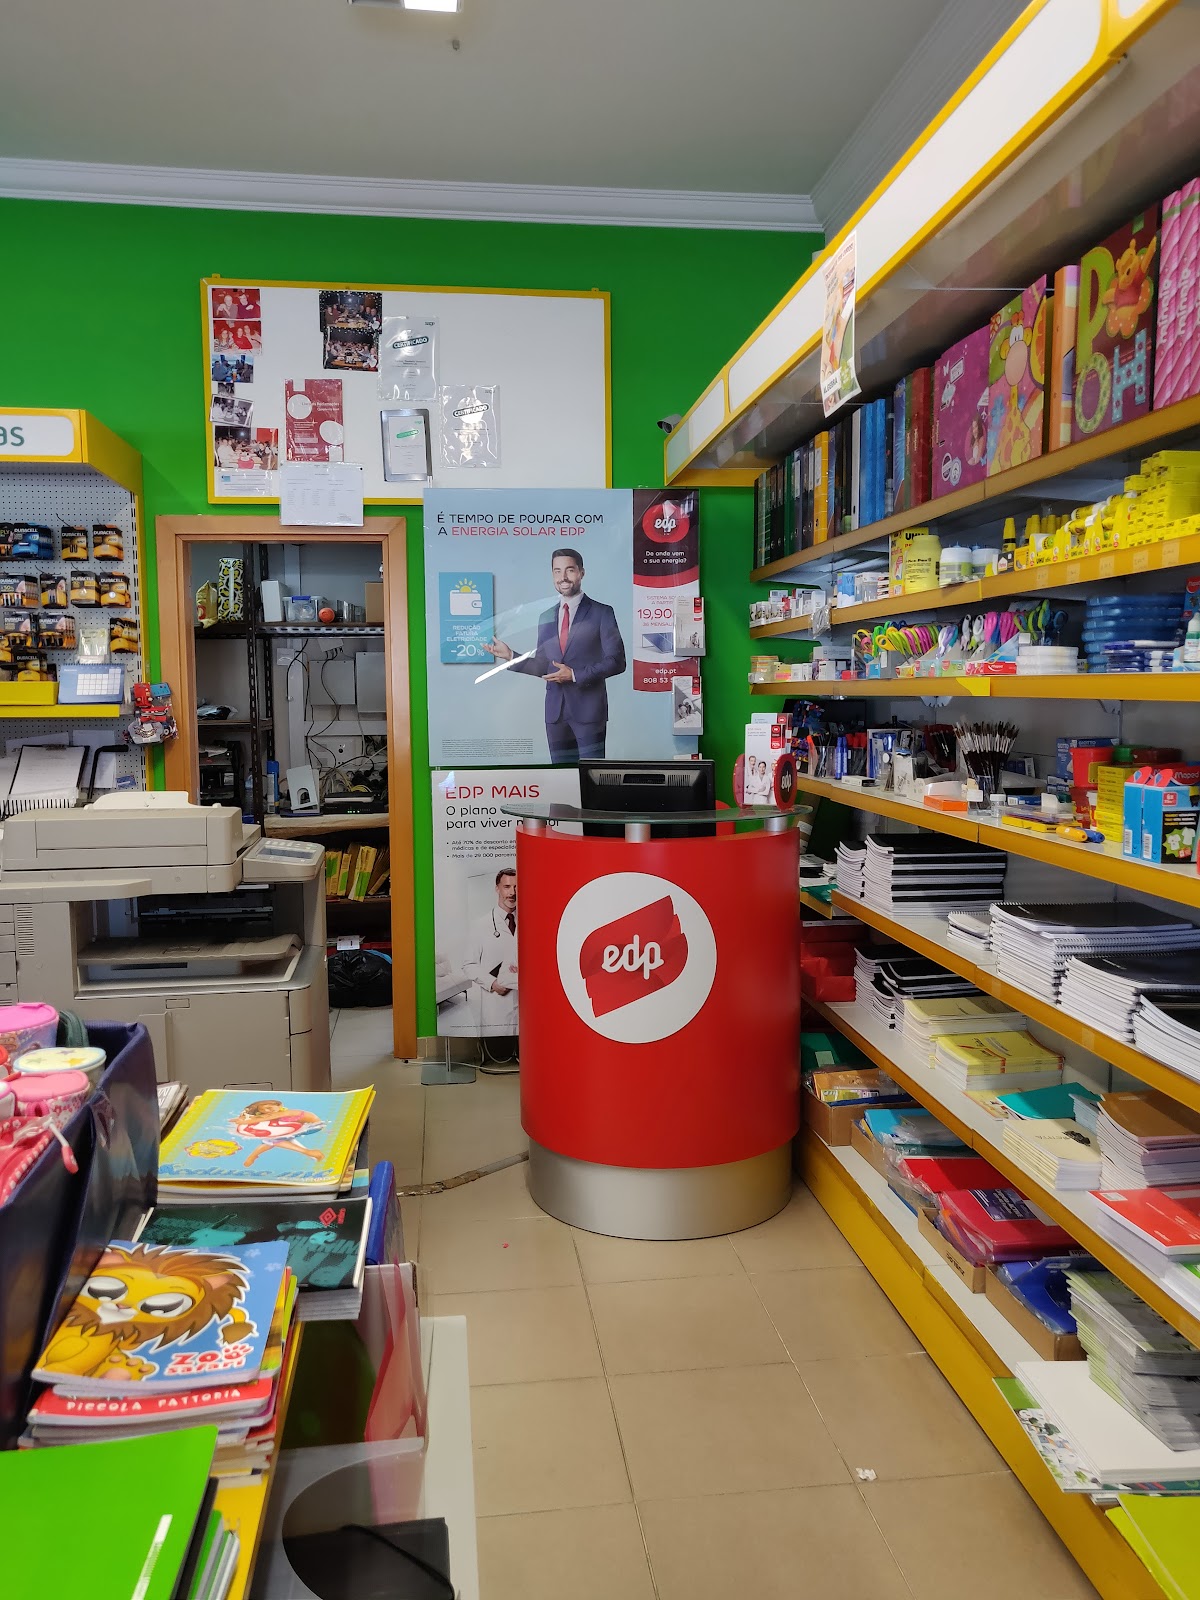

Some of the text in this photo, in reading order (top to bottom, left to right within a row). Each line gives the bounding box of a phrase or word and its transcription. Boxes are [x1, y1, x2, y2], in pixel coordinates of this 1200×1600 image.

[437, 512, 604, 524] É TEMPO DE POUPAR COM
[438, 527, 585, 536] A ENERGIA SOLAR EDP
[1174, 772, 1200, 780] Maped
[446, 785, 540, 799] EDP MAIS
[446, 806, 456, 815] O
[460, 805, 496, 817] plano
[446, 820, 476, 830] para
[481, 818, 512, 827] viver
[601, 934, 665, 980] edp
[173, 1346, 248, 1365] ZOO
[165, 1358, 244, 1376] safari
